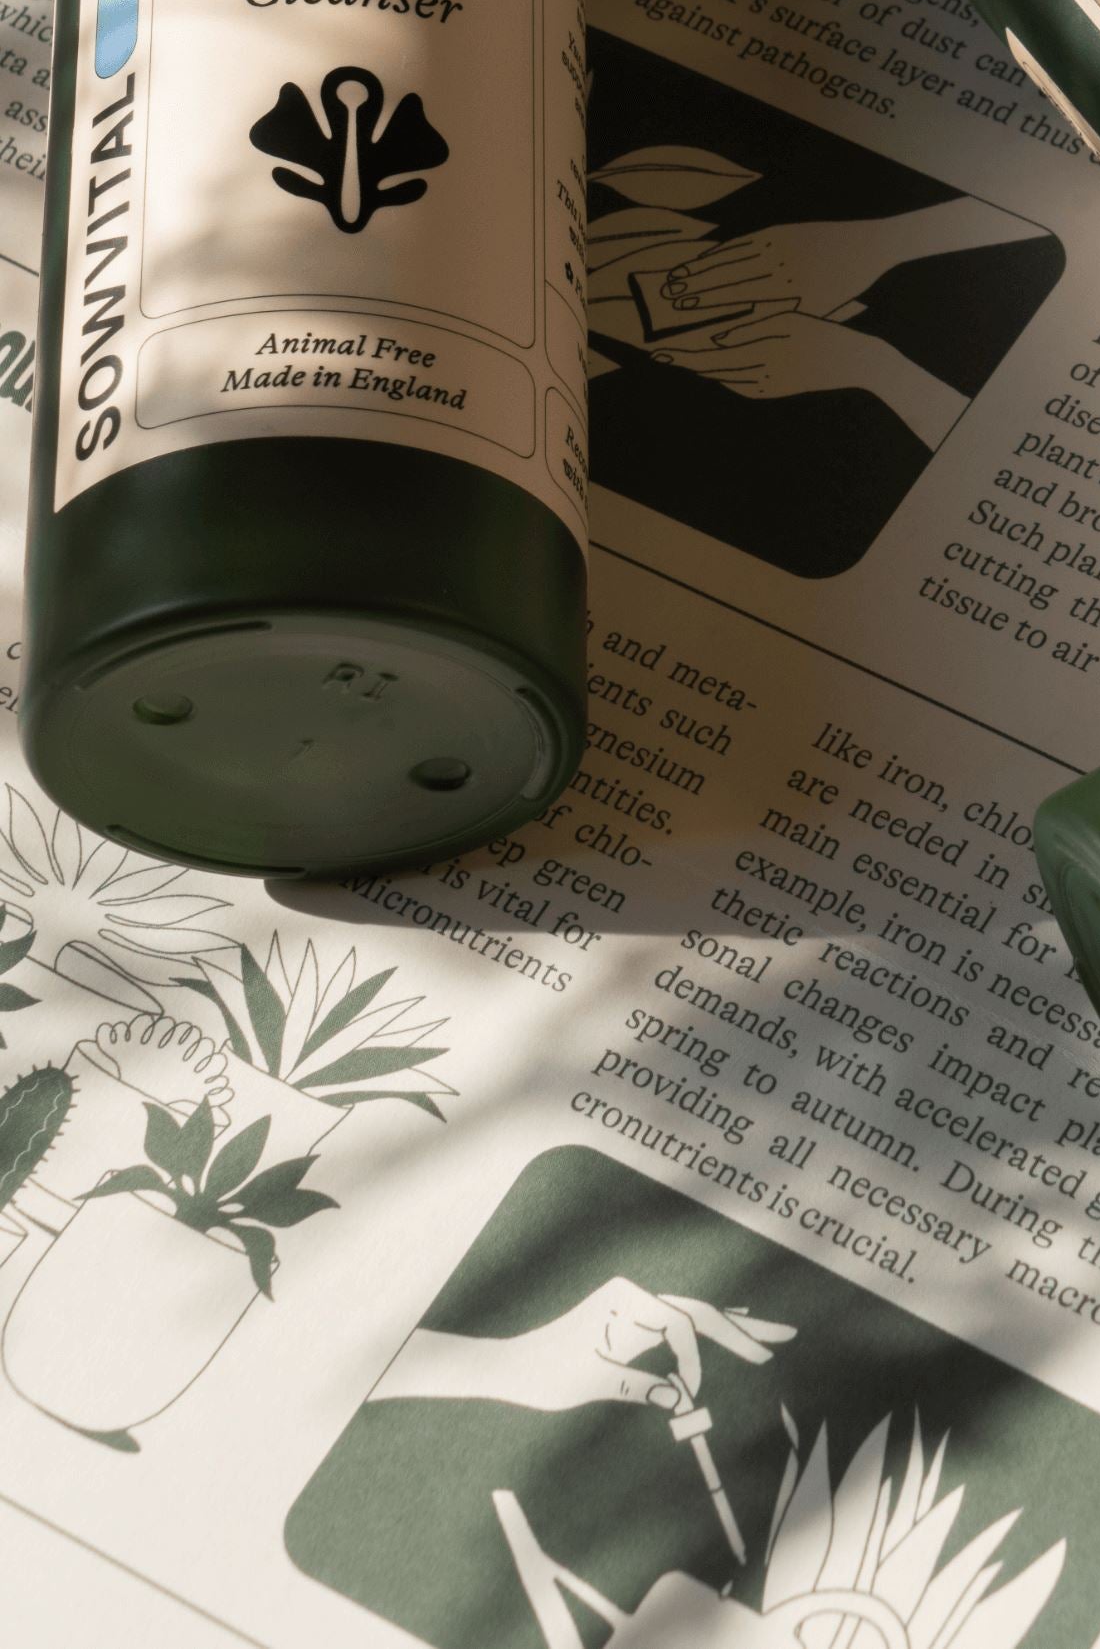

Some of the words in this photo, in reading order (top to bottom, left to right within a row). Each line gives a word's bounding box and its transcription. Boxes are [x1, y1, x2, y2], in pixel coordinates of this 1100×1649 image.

[736, 36, 895, 118] pathogens.
[768, 5, 876, 62] surface
[877, 47, 955, 96] layer
[900, 16, 967, 59] dust
[76, 72, 135, 461] SOWVITAL
[221, 366, 305, 392] Made
[313, 366, 342, 387] in
[348, 369, 467, 410] England
[255, 333, 366, 356] Animal
[371, 339, 437, 368] Free
[966, 499, 1044, 552] Such
[918, 575, 1009, 631] tissue
[943, 542, 1059, 610] cutting
[658, 708, 731, 756] such
[810, 722, 872, 769] like
[876, 754, 948, 812] iron,
[758, 807, 840, 860] main
[851, 853, 997, 934] essential
[847, 798, 969, 867] needed
[476, 879, 551, 929] vital
[532, 858, 625, 913] green
[734, 850, 866, 933] example,
[877, 911, 946, 966] iron
[710, 887, 805, 946] thetic
[817, 943, 970, 1026] reactions
[680, 929, 772, 983] sonal
[783, 978, 914, 1053] changes
[927, 1042, 1046, 1122] impact
[654, 965, 797, 1058] demands,
[815, 1044, 886, 1097] with
[894, 1087, 1087, 1199] accelerated
[590, 1048, 754, 1145] providing
[826, 1165, 992, 1264] necessary
[625, 1009, 731, 1077] spring
[790, 1091, 919, 1172] autumn.
[939, 1159, 1063, 1248] During
[570, 1091, 768, 1202] cronutrients
[798, 1208, 917, 1284] crucial.
